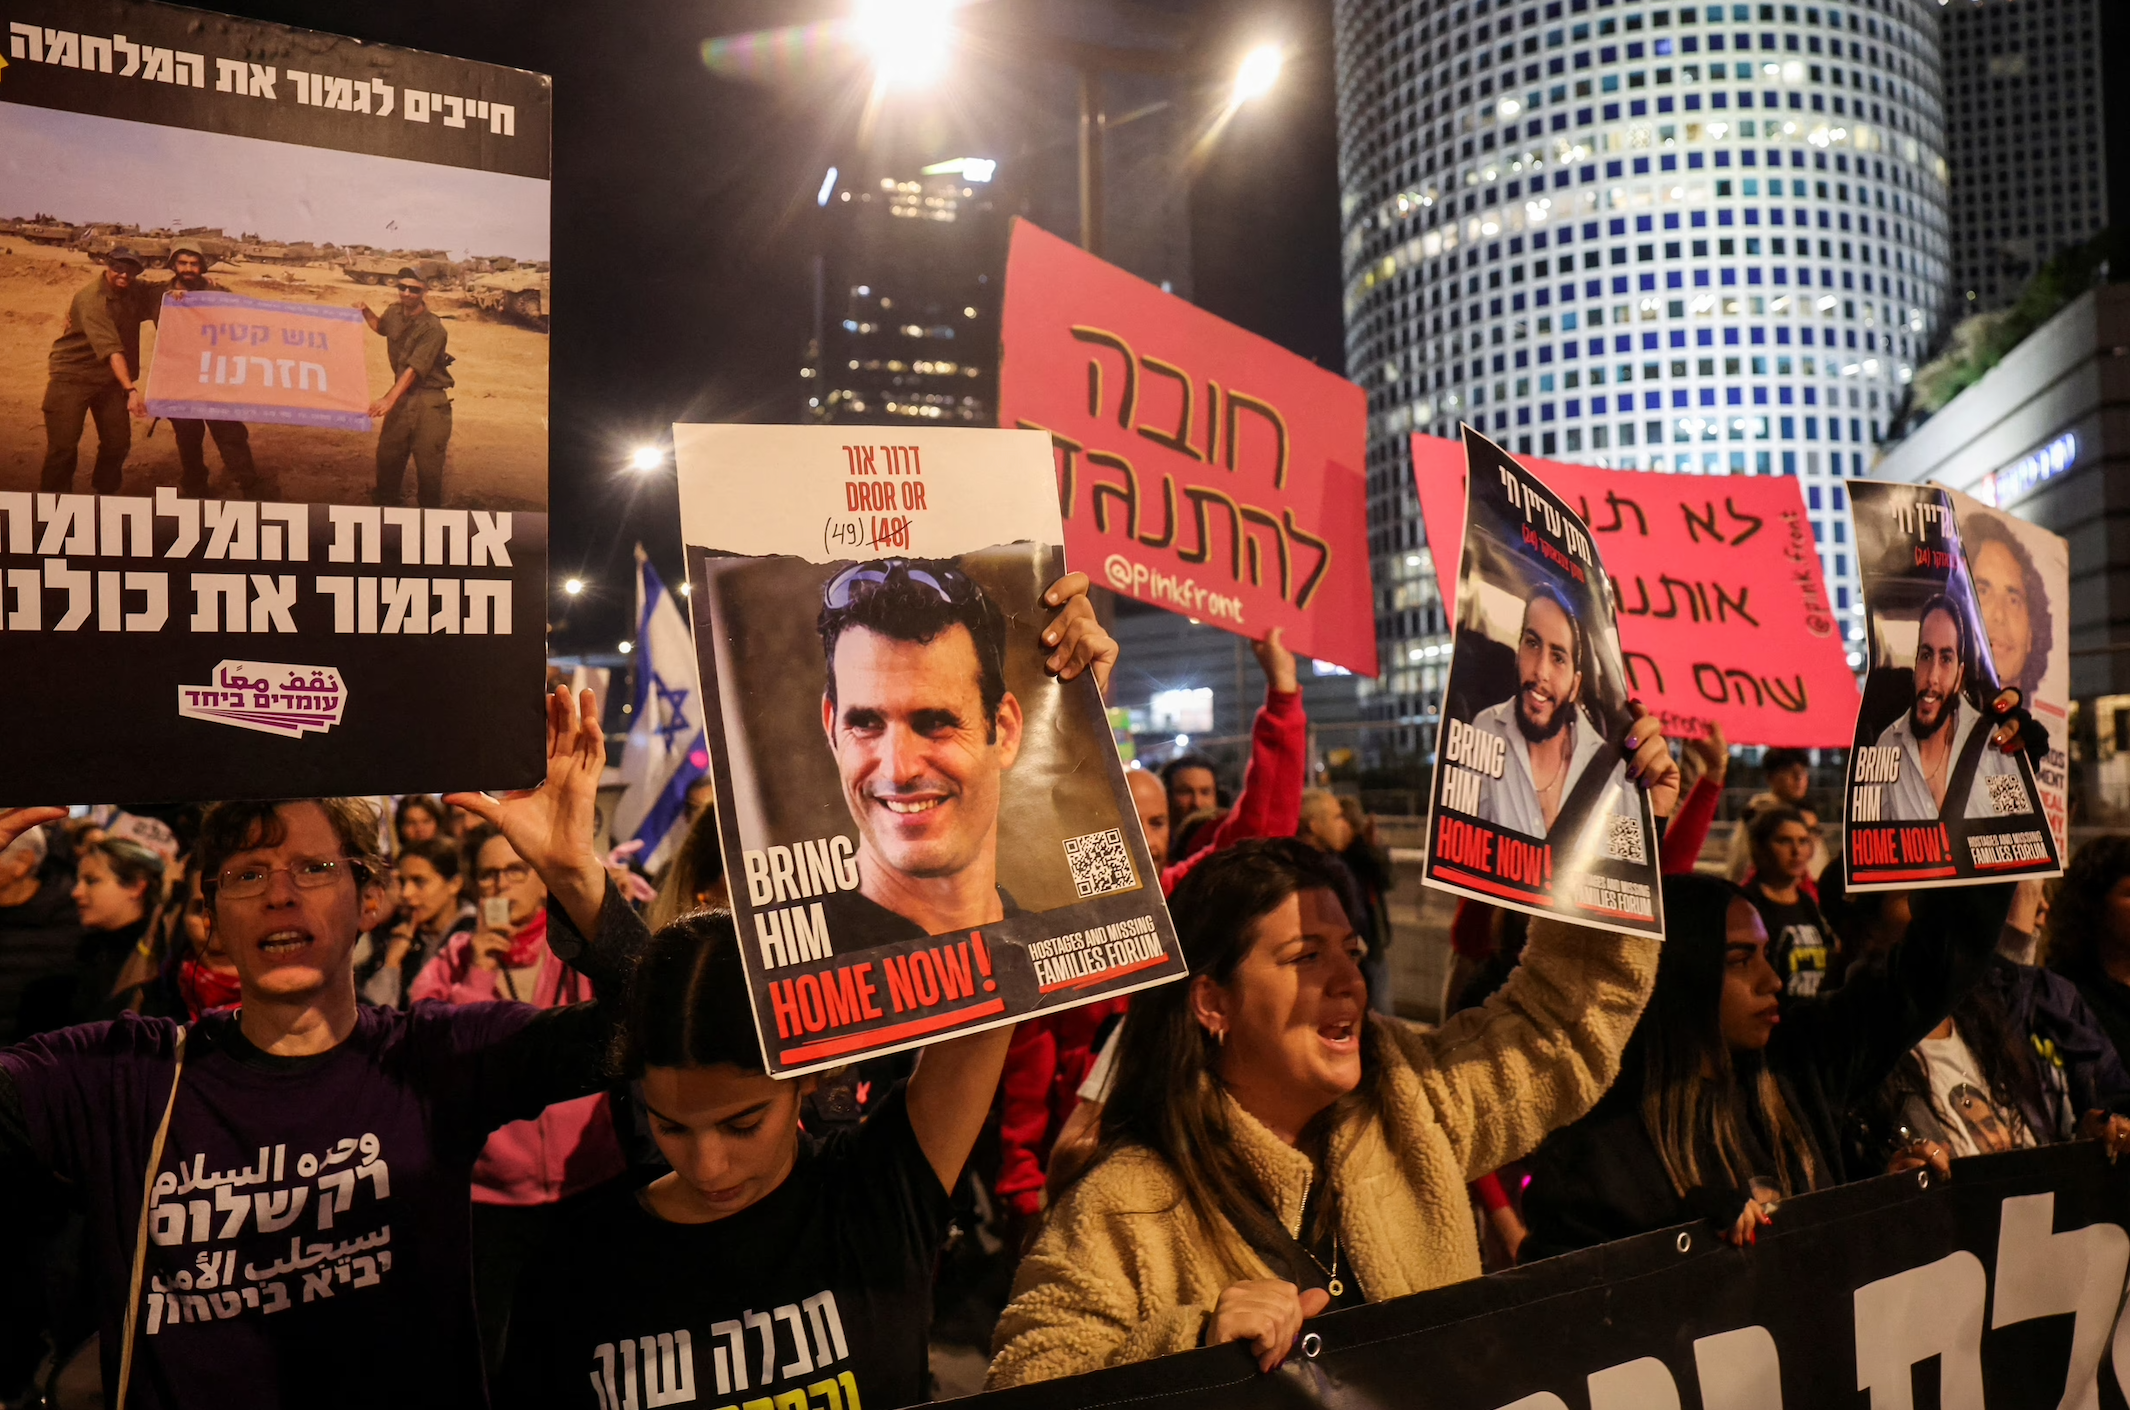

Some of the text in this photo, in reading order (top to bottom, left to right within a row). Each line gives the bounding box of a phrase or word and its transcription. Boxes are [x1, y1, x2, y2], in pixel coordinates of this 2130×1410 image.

[10, 21, 515, 137] חייבים לגמור את המלחמה
[201, 322, 329, 351] גוש קטיף
[198, 351, 328, 393] חזרנו!
[1069, 323, 1291, 491] חובה
[842, 445, 922, 476] דרור אור
[845, 480, 928, 512] DROR OR
[1015, 417, 1332, 612] להתנגד
[1498, 464, 1594, 568] מתן עדיין חי
[1680, 496, 1764, 547] לא
[0, 486, 514, 568] אחרת המלחמה
[824, 516, 865, 555] (49)
[871, 514, 911, 552] (48)
[1914, 545, 1931, 569] (24)
[0, 558, 513, 635] תגמור את כולנ
[1610, 572, 1760, 628] אותנו
[184, 690, 339, 712] עומדים ביחד
[279, 670, 339, 693] نقف
[1692, 662, 1808, 714] שהם
[1445, 717, 1506, 780] BRING
[1854, 746, 1901, 784] BRING
[1440, 763, 1483, 818] HIM
[1851, 785, 1882, 823] HIM
[1436, 814, 1554, 892] HOME NOW!
[1851, 821, 1954, 867] HOME NOW!
[1970, 844, 2015, 865] FAMILIES
[2011, 841, 2050, 862] FORUM
[1998, 832, 2013, 846] AND
[2011, 829, 2044, 844] MISSING
[742, 834, 861, 908] BRING
[1616, 892, 1653, 917] FORUM
[753, 901, 834, 971] HIM
[1027, 914, 1156, 962] HOSTAGES AND MISSING
[1033, 931, 1165, 987] FAMILIES FORUM
[768, 930, 998, 1040] HOME NOW!
[150, 1132, 381, 1209] وحده السلام
[149, 1158, 391, 1247] רק שלום
[146, 1250, 392, 1335] יביא ביטחון
[710, 1289, 850, 1396] תכלה
